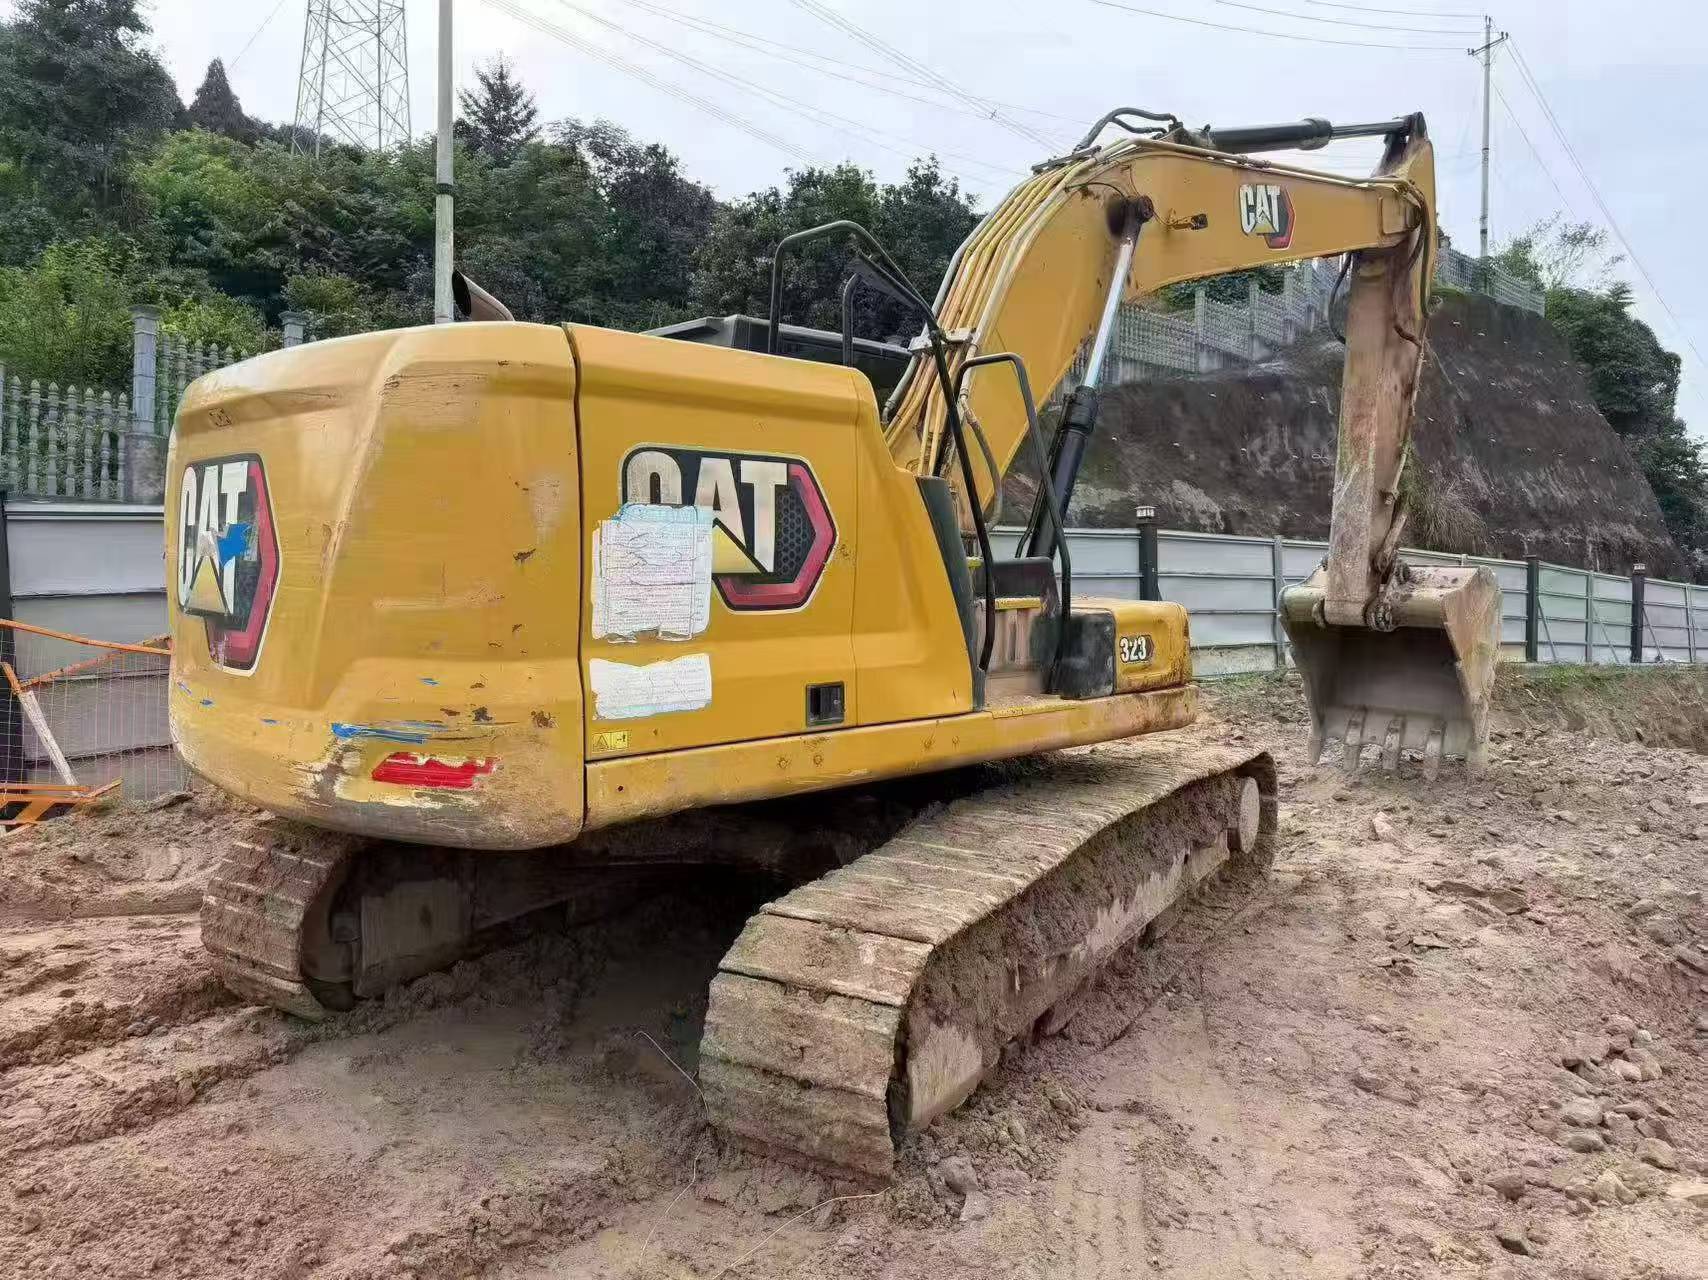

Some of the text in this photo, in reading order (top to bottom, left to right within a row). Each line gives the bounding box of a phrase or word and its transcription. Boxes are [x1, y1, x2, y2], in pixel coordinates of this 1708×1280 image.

[1240, 184, 1280, 233] CAT
[178, 461, 248, 614] CAT
[1120, 636, 1147, 662] 323
